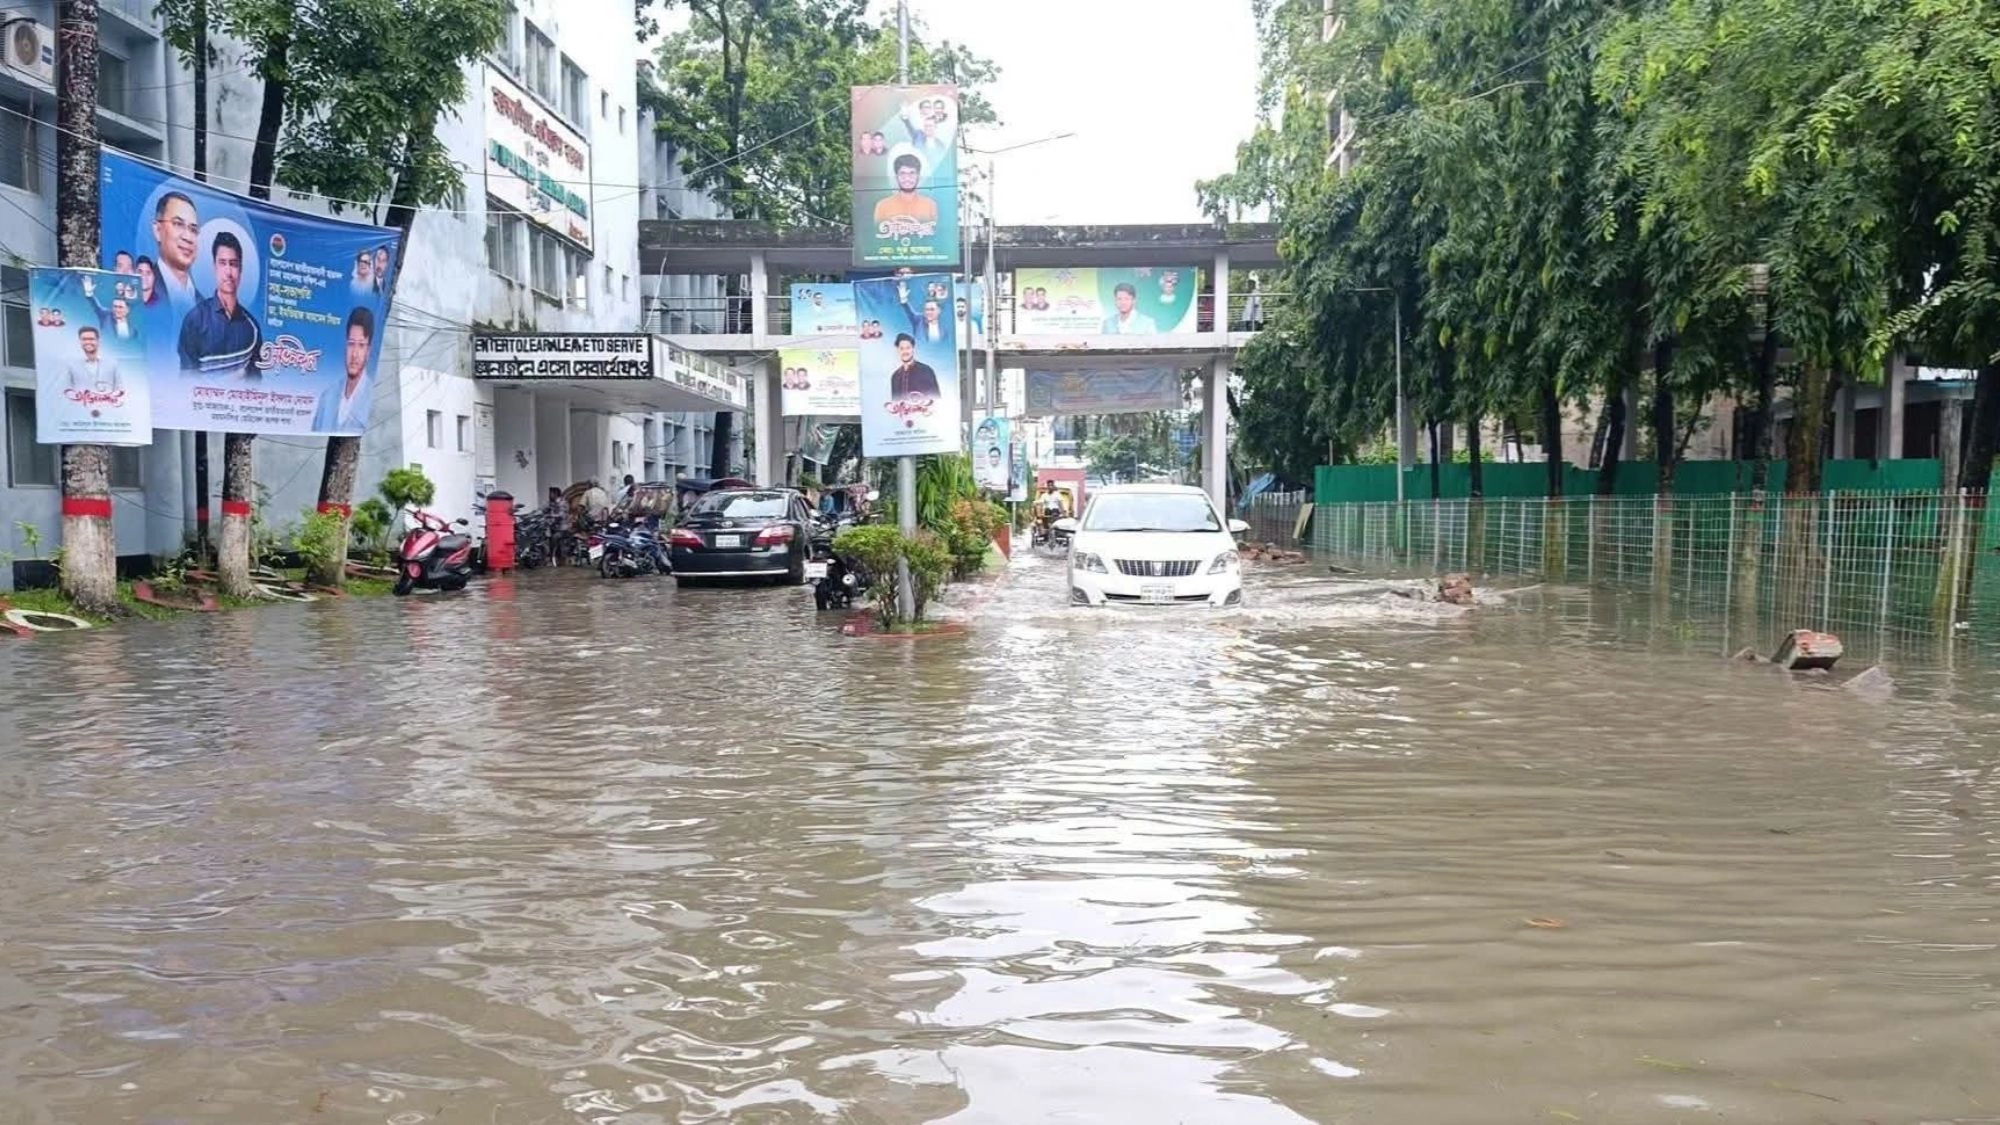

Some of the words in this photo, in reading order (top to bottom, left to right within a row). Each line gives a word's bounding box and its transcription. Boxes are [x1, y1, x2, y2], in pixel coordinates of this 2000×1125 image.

[475, 339, 508, 353] ENTER
[591, 339, 605, 353] TO
[606, 339, 643, 353] SERVE
[538, 359, 571, 376] এসো
